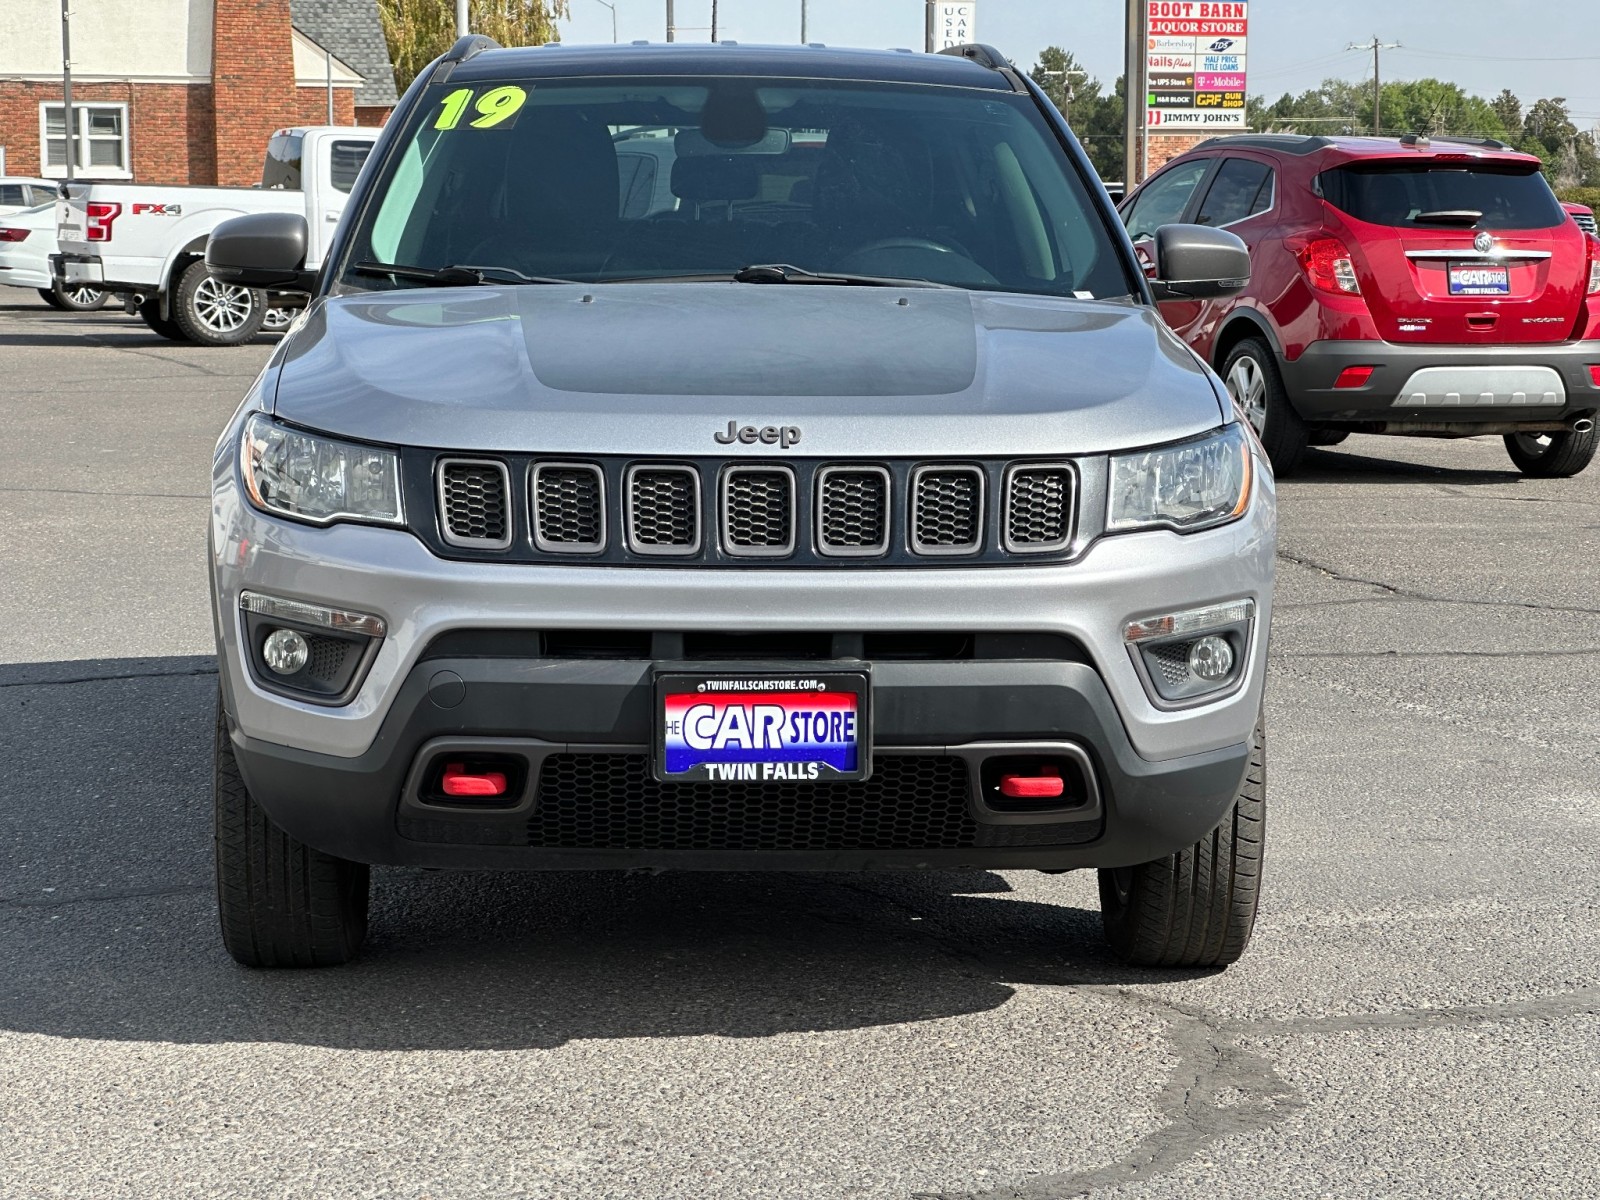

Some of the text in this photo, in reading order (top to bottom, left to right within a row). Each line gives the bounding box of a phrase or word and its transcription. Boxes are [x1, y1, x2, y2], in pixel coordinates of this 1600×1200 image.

[1149, 2, 1243, 17] BOOT BARN
[1149, 22, 1243, 34] LIQUOR STORE
[1173, 58, 1192, 69] Plus
[434, 86, 527, 130] 19
[1164, 114, 1239, 123] JIMMY JOHN'S
[132, 203, 181, 214] FX4
[1460, 270, 1489, 285] CAR
[1490, 272, 1507, 283] STOR
[713, 420, 802, 449] Jeep
[706, 679, 817, 691] TWINFALLSCARSTORE.COM
[666, 702, 855, 750] HE CAR STORE
[706, 762, 819, 781] TWIN FALLS
